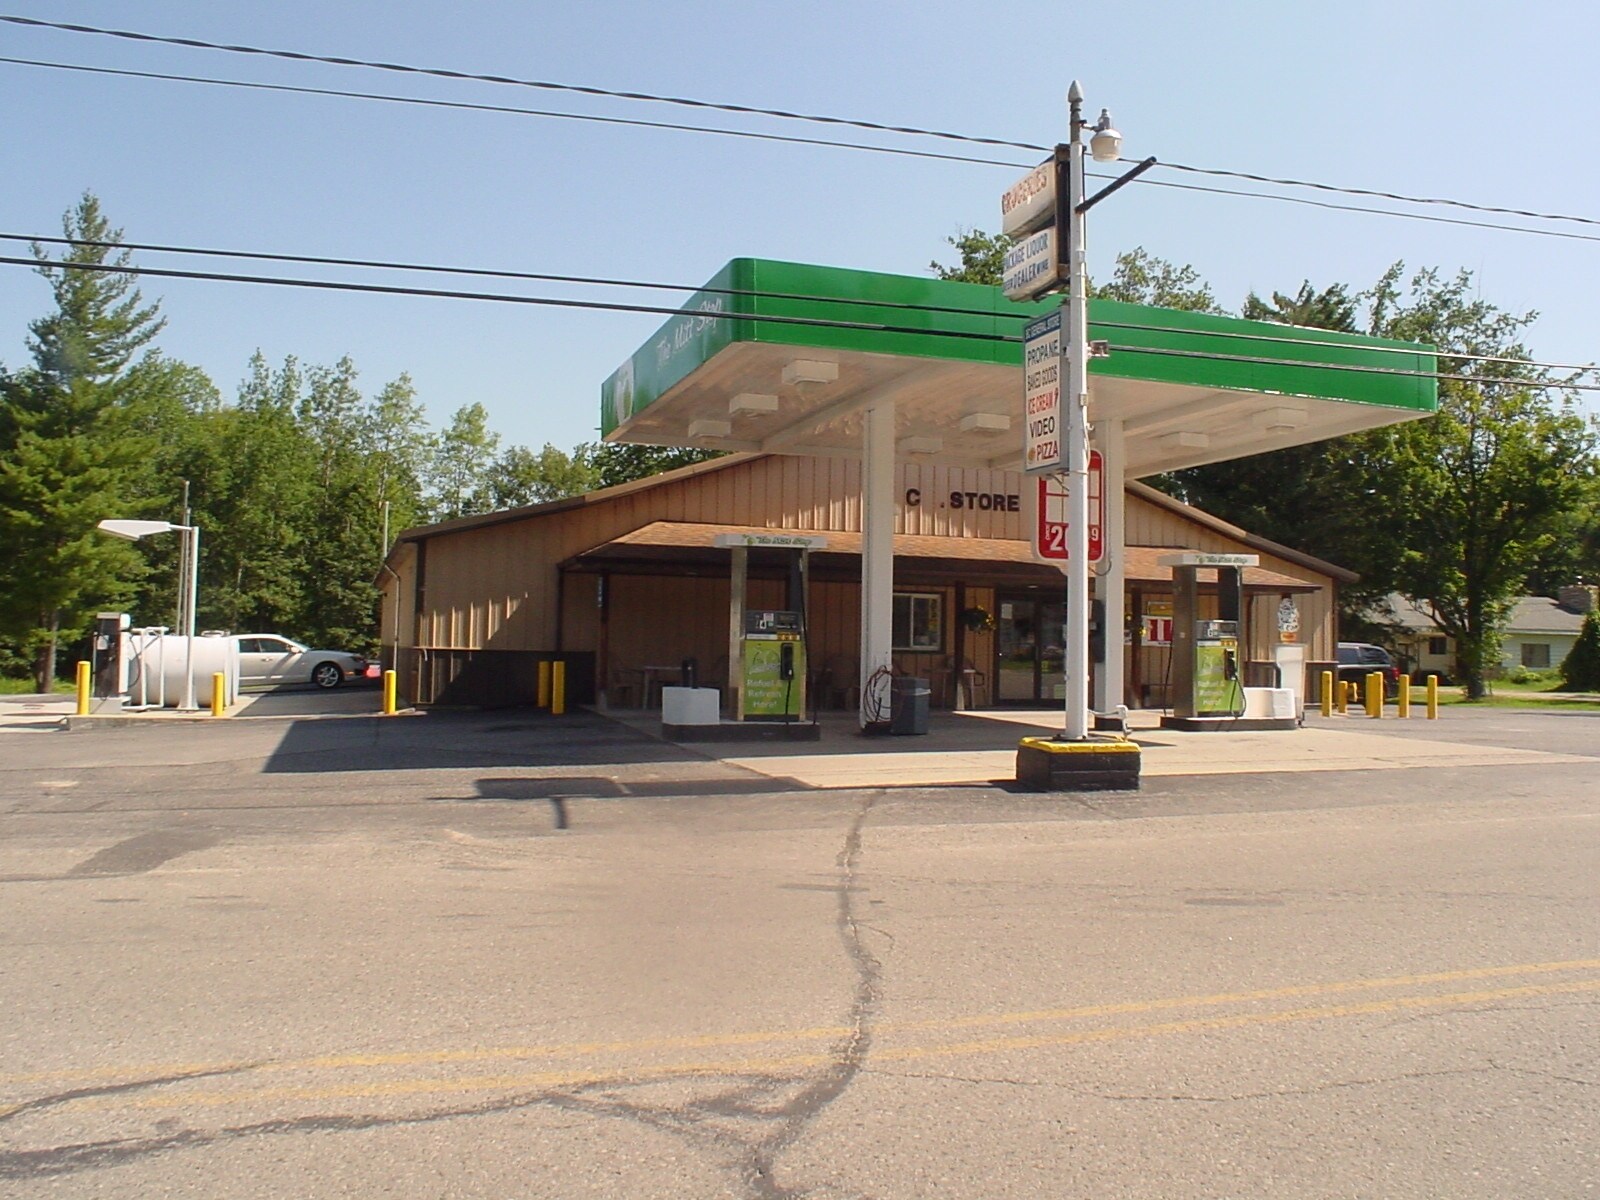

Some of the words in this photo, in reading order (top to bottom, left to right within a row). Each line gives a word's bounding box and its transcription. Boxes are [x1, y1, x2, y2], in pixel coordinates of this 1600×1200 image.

[1026, 232, 1048, 259] LIQUOR
[1013, 262, 1037, 290] DEALER
[1027, 339, 1059, 367] PROPANE
[1029, 415, 1055, 438] VIDEO
[1036, 440, 1059, 461] PIZZA
